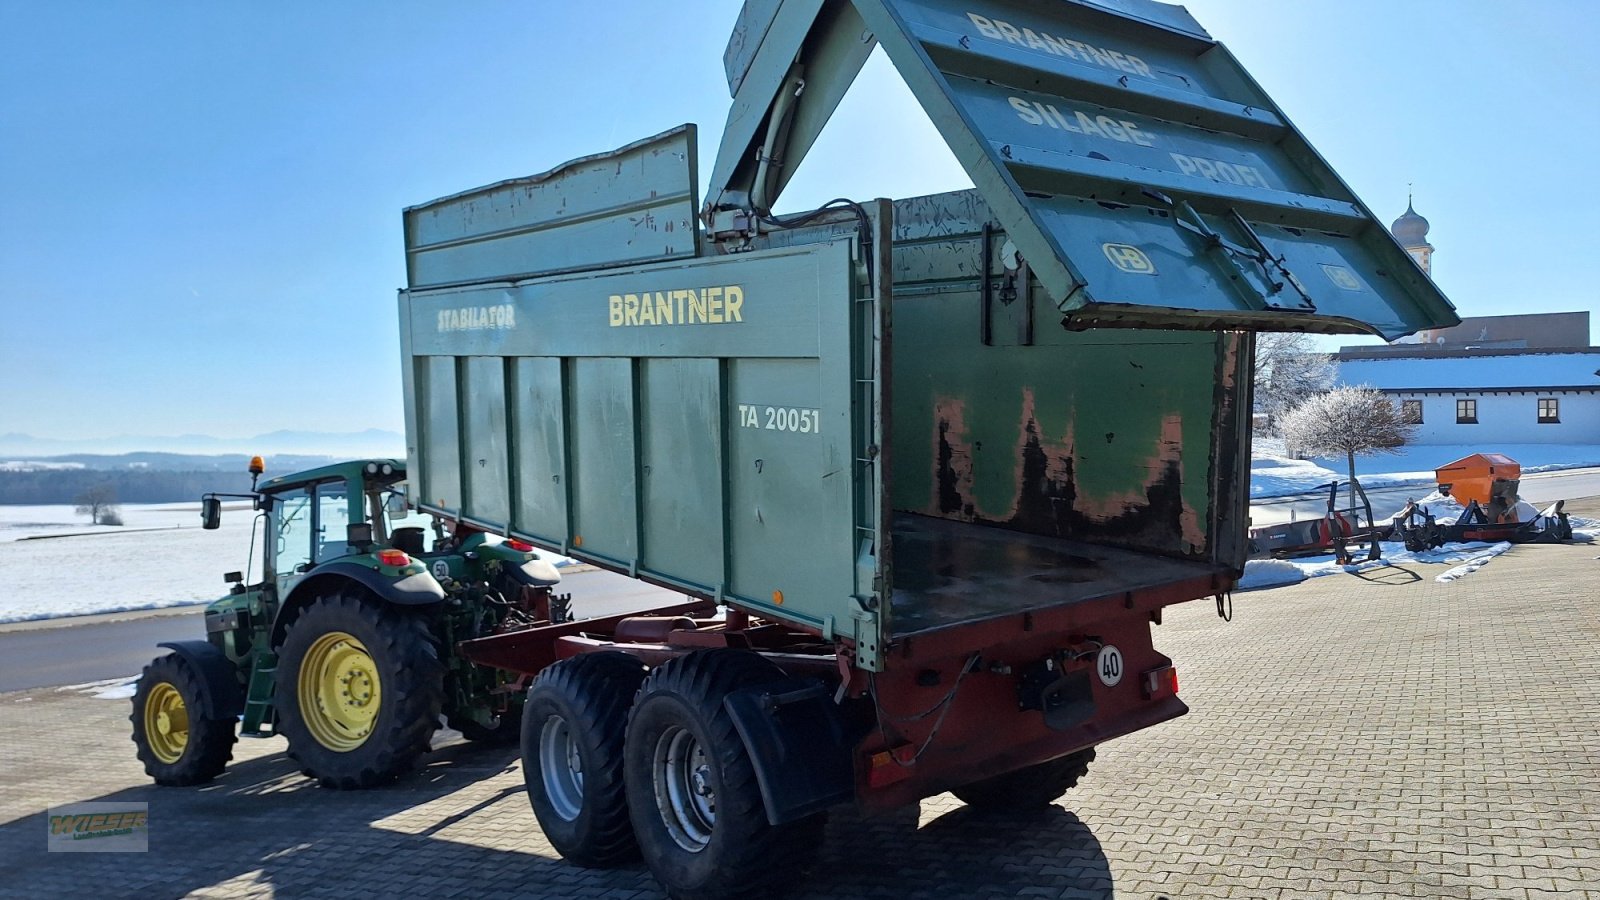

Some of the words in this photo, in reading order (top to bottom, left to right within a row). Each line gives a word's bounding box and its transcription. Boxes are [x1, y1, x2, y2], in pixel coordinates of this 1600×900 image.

[966, 12, 1155, 79] BRANTNER
[1168, 151, 1271, 190] PROFI
[437, 304, 516, 333] STABILATOR
[608, 286, 745, 327] BRANTNER
[738, 404, 760, 429] TA
[765, 407, 821, 434] 20051
[435, 563, 447, 577] 50
[1102, 651, 1120, 679] 40
